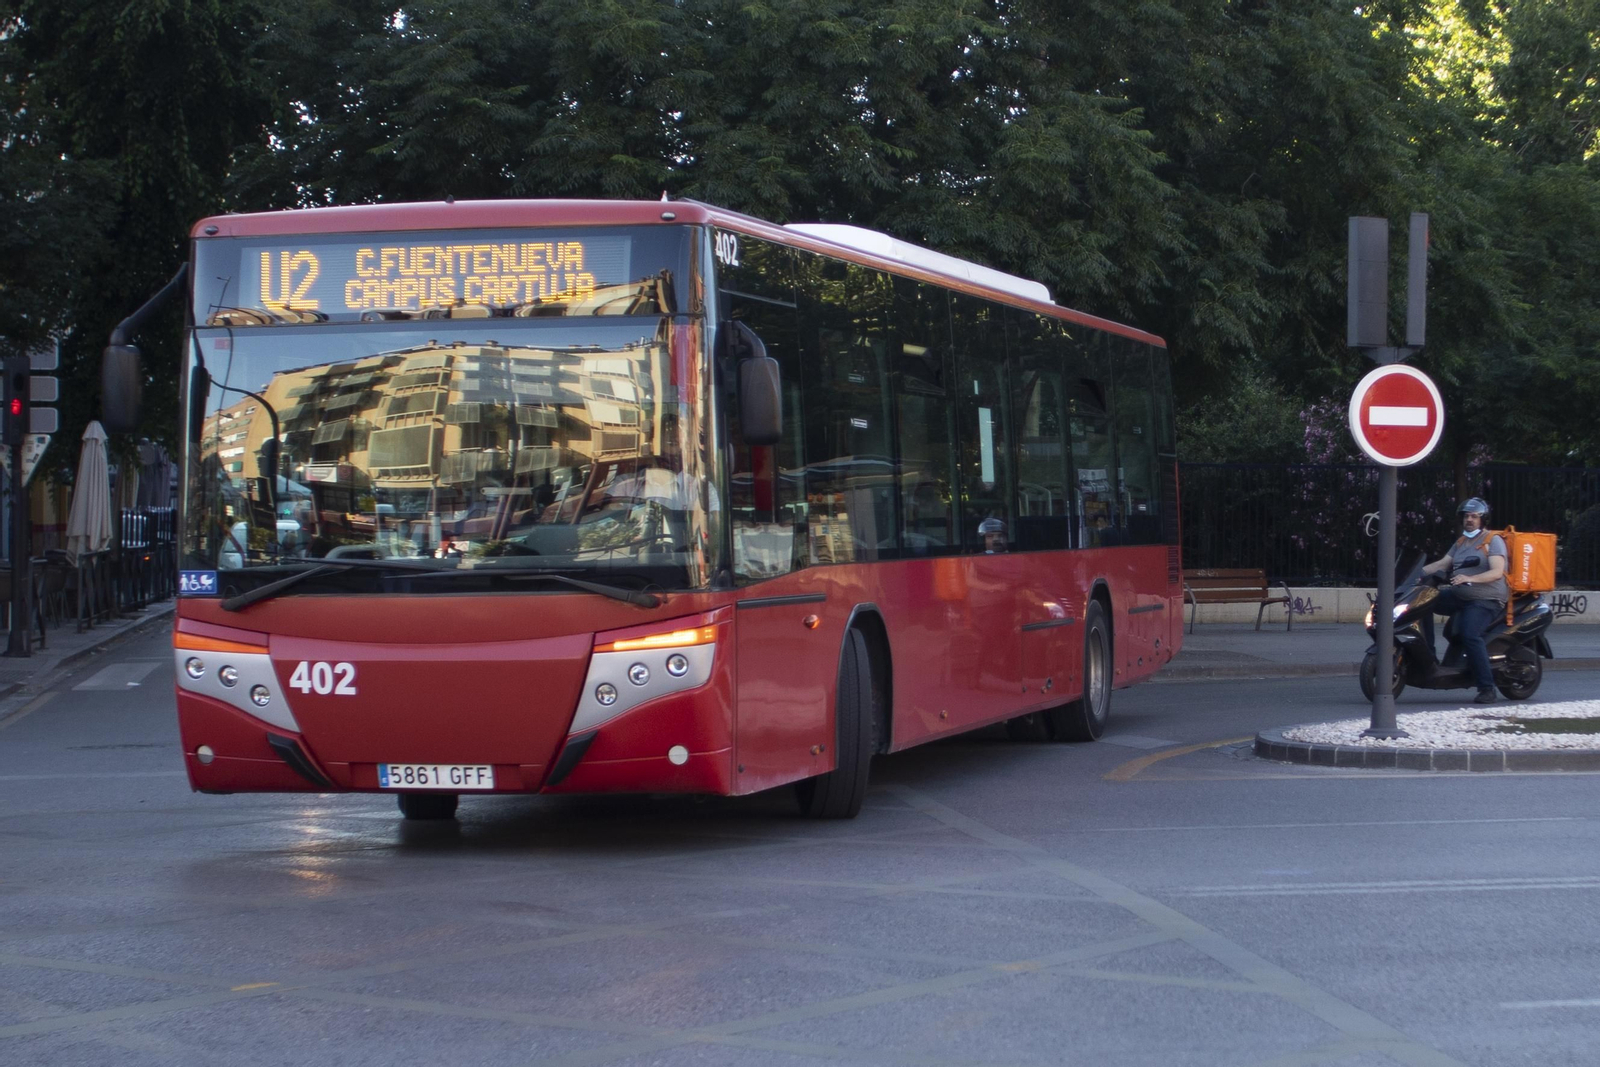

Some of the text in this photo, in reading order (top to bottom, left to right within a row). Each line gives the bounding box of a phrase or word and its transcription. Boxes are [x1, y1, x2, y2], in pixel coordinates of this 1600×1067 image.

[356, 241, 583, 277] C.FUENTENUEVA
[714, 230, 739, 267] 402
[261, 251, 319, 310] U2
[345, 272, 594, 309] CAMPUS CARTUJA
[289, 661, 357, 695] 402
[390, 766, 488, 785] 5861 GFF
